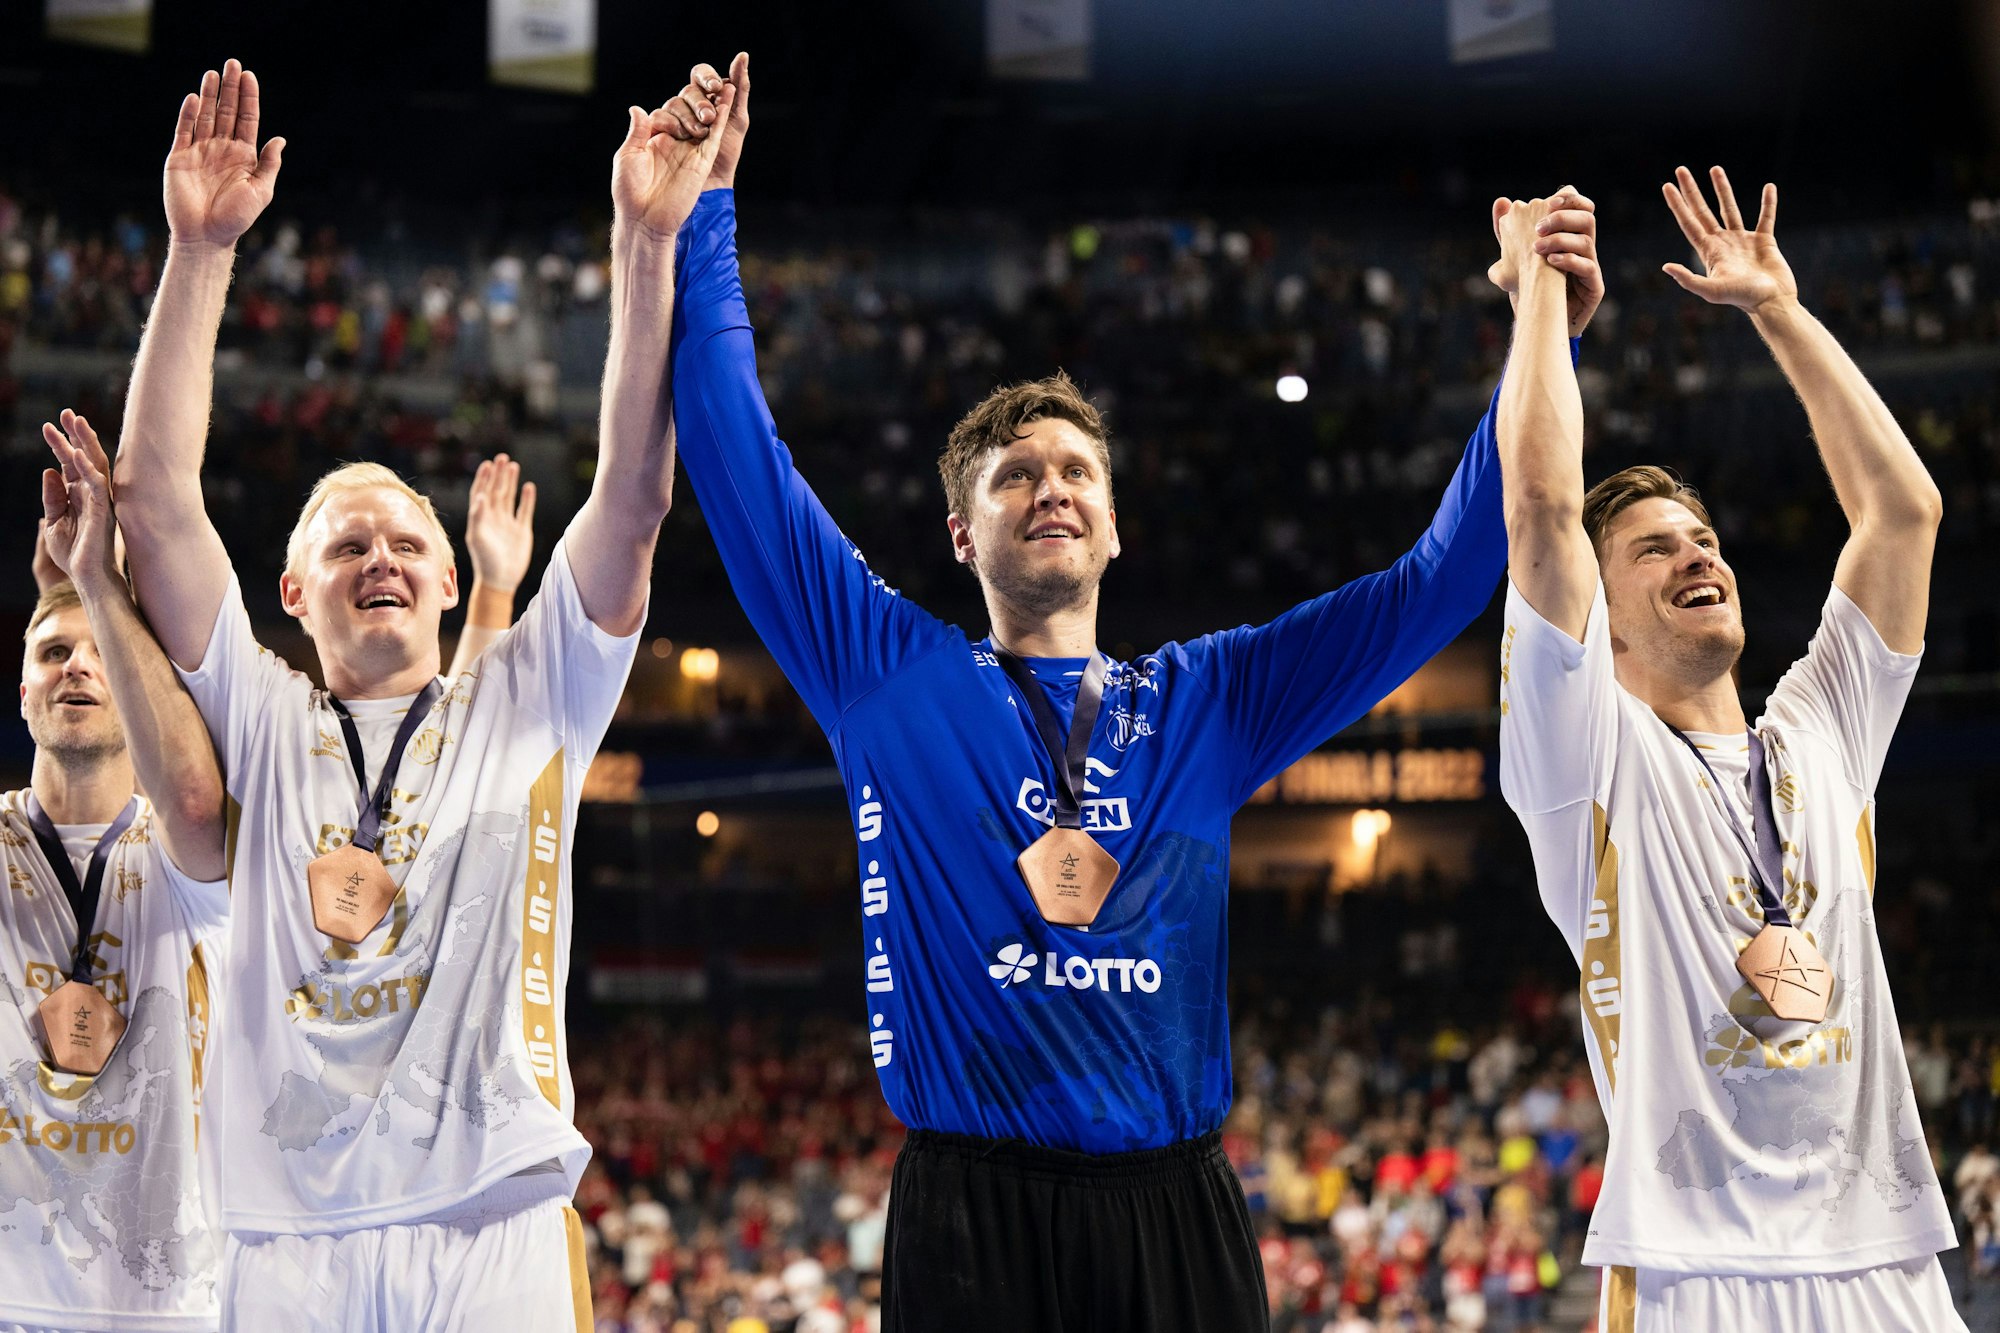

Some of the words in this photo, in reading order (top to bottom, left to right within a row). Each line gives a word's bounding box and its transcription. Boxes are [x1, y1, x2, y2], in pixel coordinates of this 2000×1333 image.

[1025, 787, 1122, 828] OEN
[325, 829, 424, 858] OEN
[1045, 952, 1161, 993] LOTTO
[332, 975, 430, 1021] LOTT
[24, 1114, 136, 1154] LOTTO
